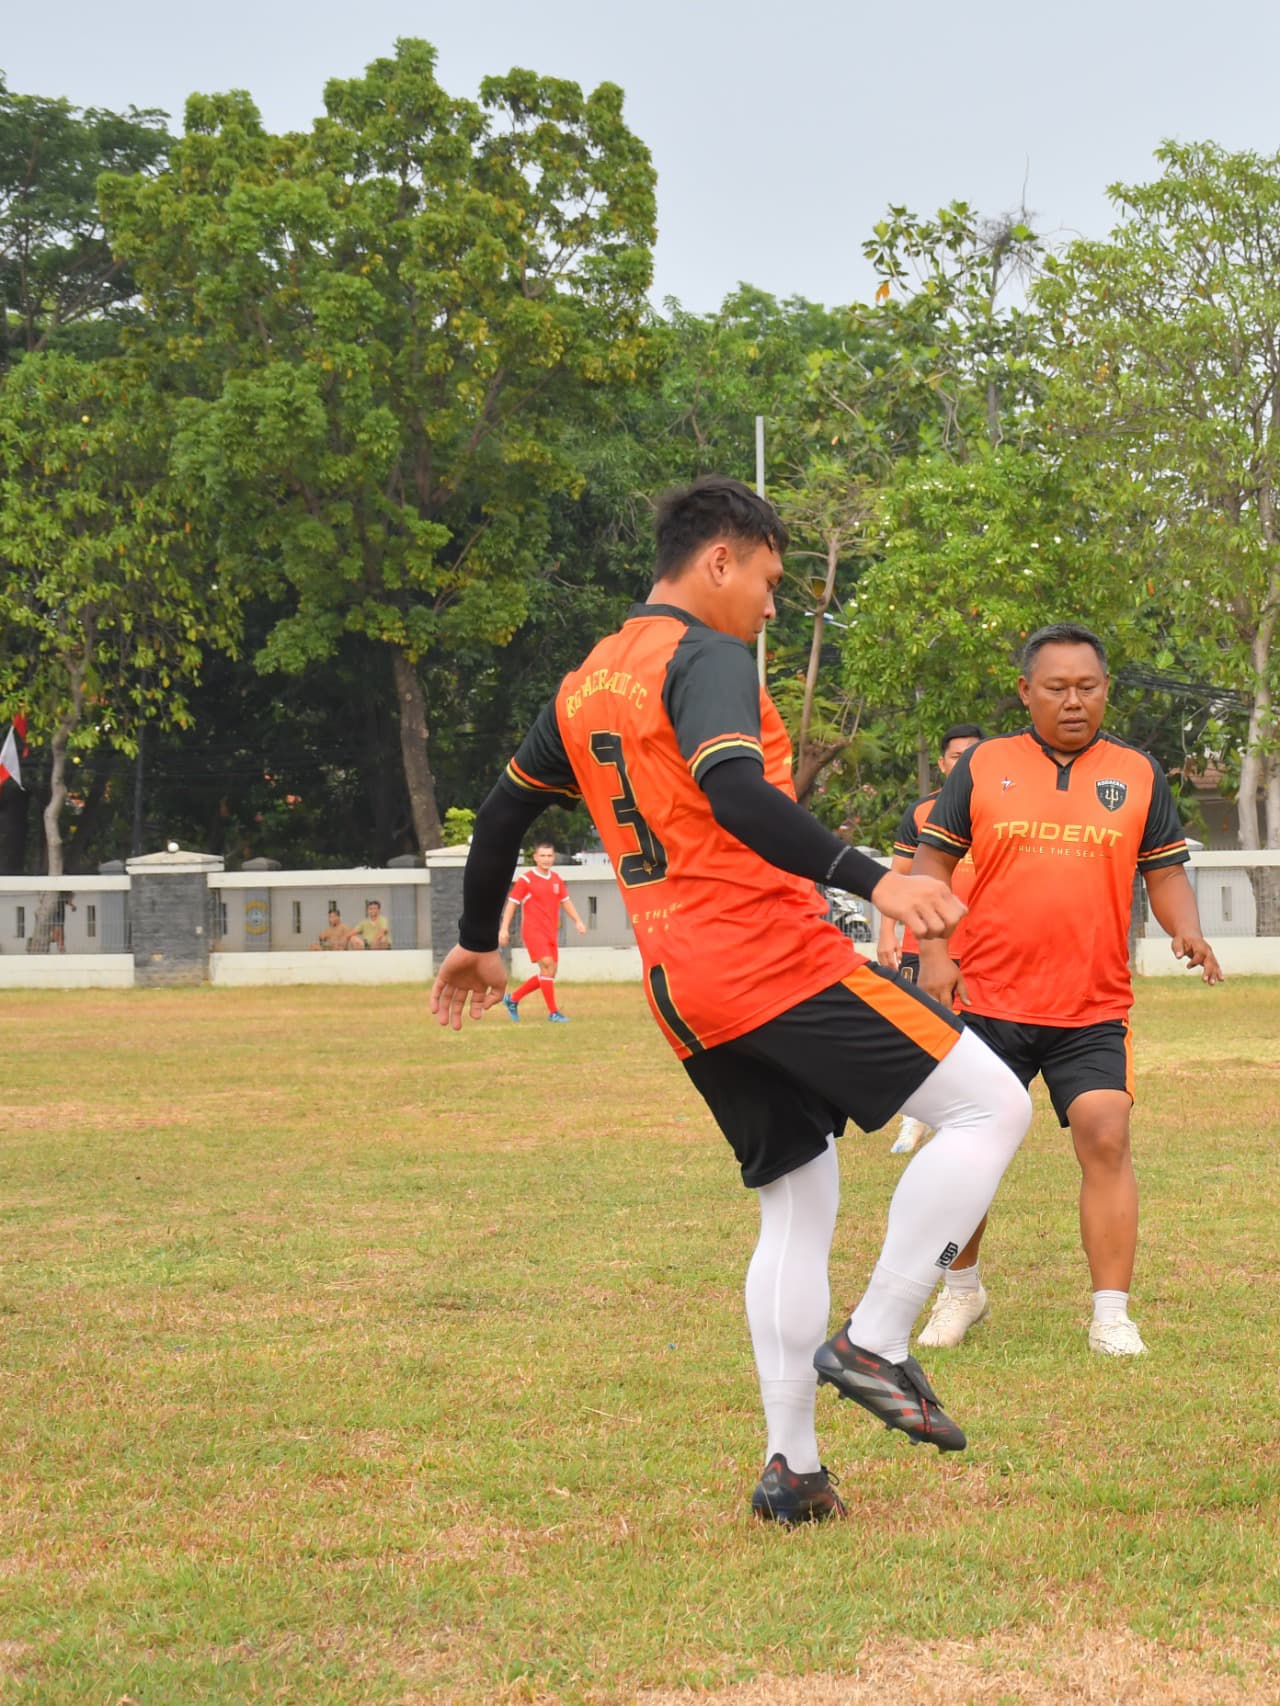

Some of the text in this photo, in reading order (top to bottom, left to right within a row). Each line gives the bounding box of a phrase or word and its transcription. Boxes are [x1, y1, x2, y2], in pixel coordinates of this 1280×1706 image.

[588, 729, 668, 889] 3
[993, 820, 1124, 847] TRIDENT
[1050, 847, 1071, 856] THE
[1075, 849, 1096, 858] SEA
